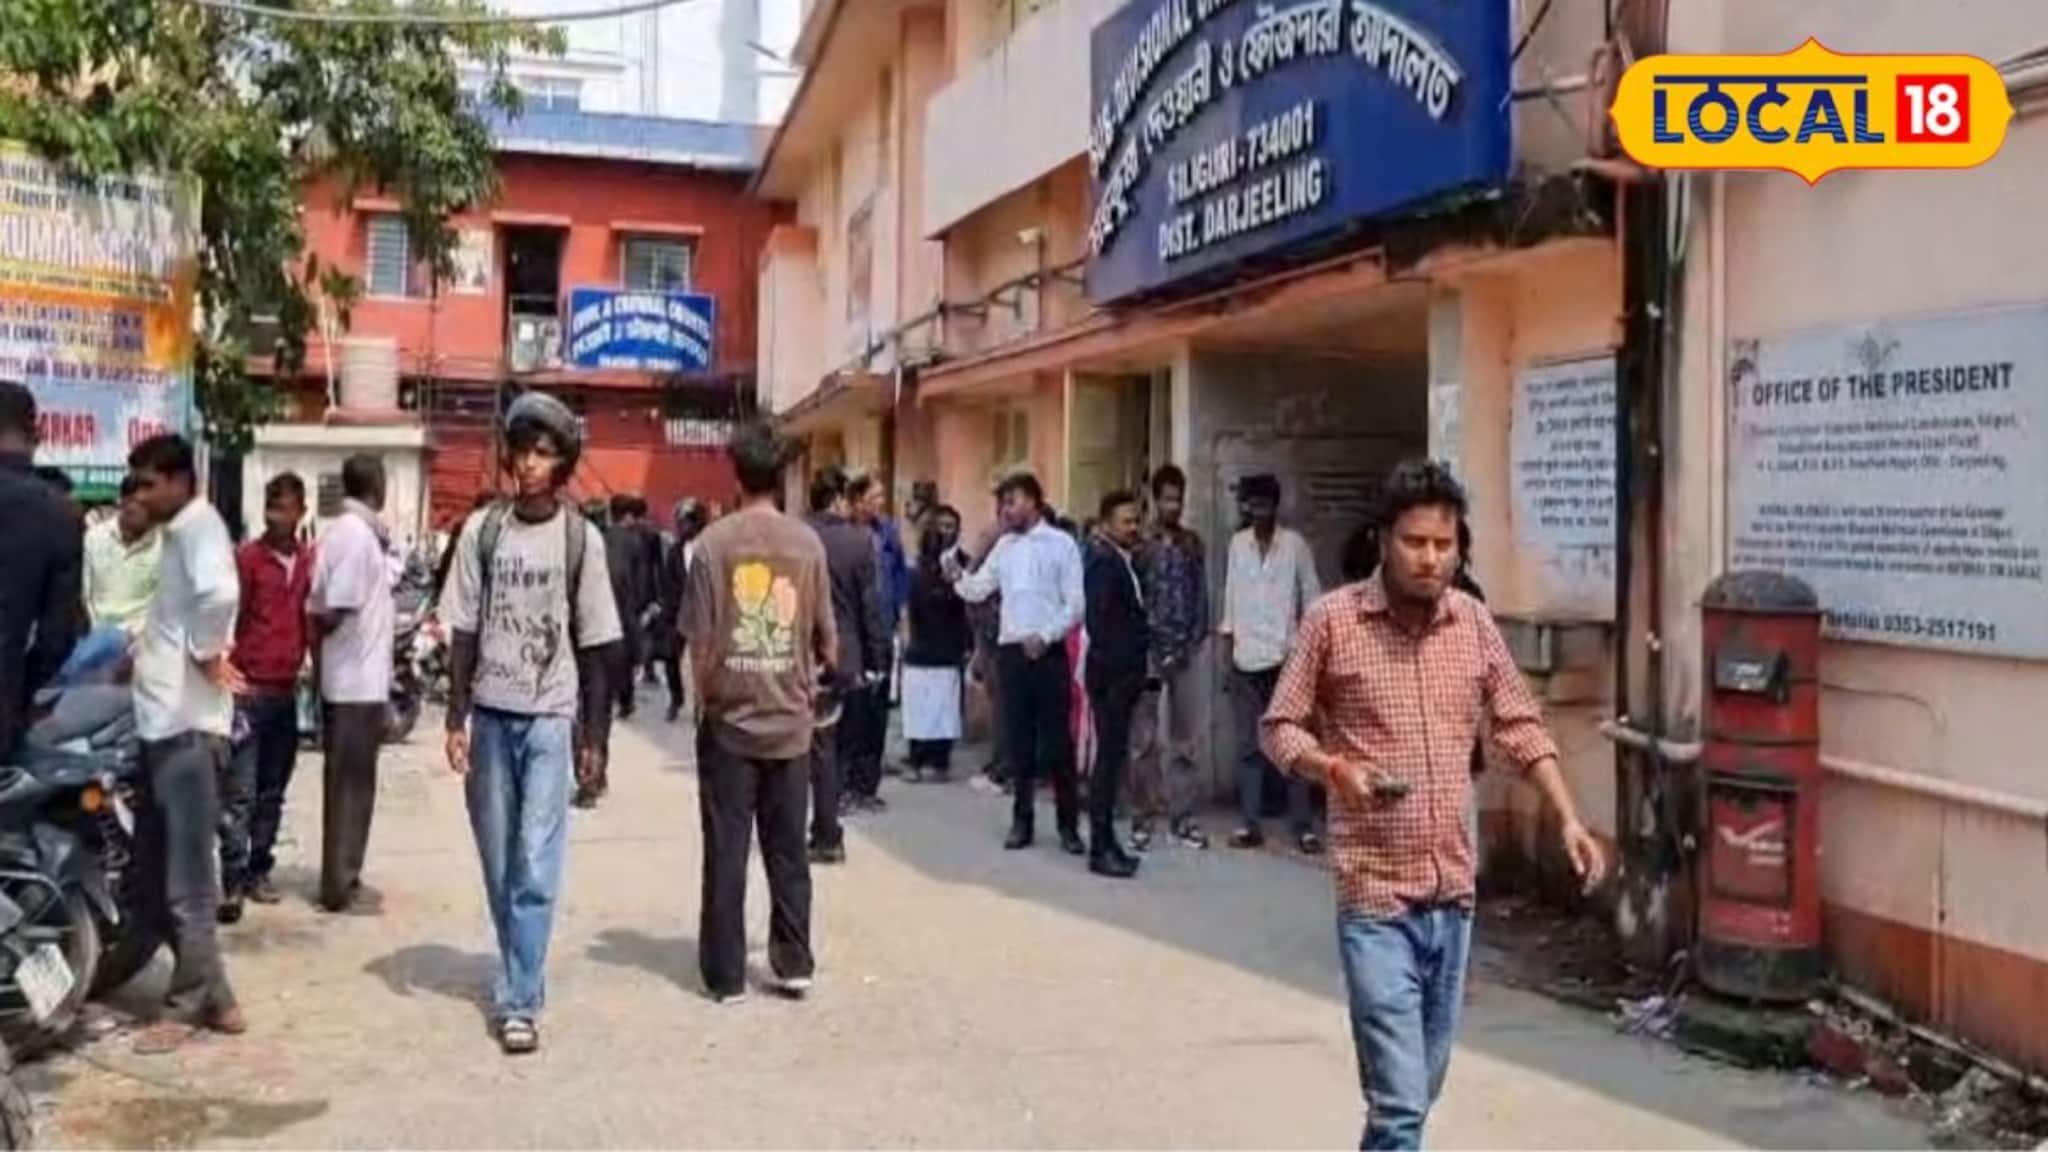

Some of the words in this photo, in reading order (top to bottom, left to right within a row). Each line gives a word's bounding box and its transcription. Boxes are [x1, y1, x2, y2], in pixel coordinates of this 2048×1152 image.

[1350, 0, 1465, 119] আদালত
[1158, 211, 1200, 260] DIST.
[1203, 157, 1323, 247] DARJEELING
[1752, 379, 1812, 406] OFFICE
[1818, 377, 1842, 402] OF
[1847, 373, 1887, 400] THE
[1892, 362, 2014, 396] PRESIDENT
[1883, 614, 1997, 641] 0353-2517191
